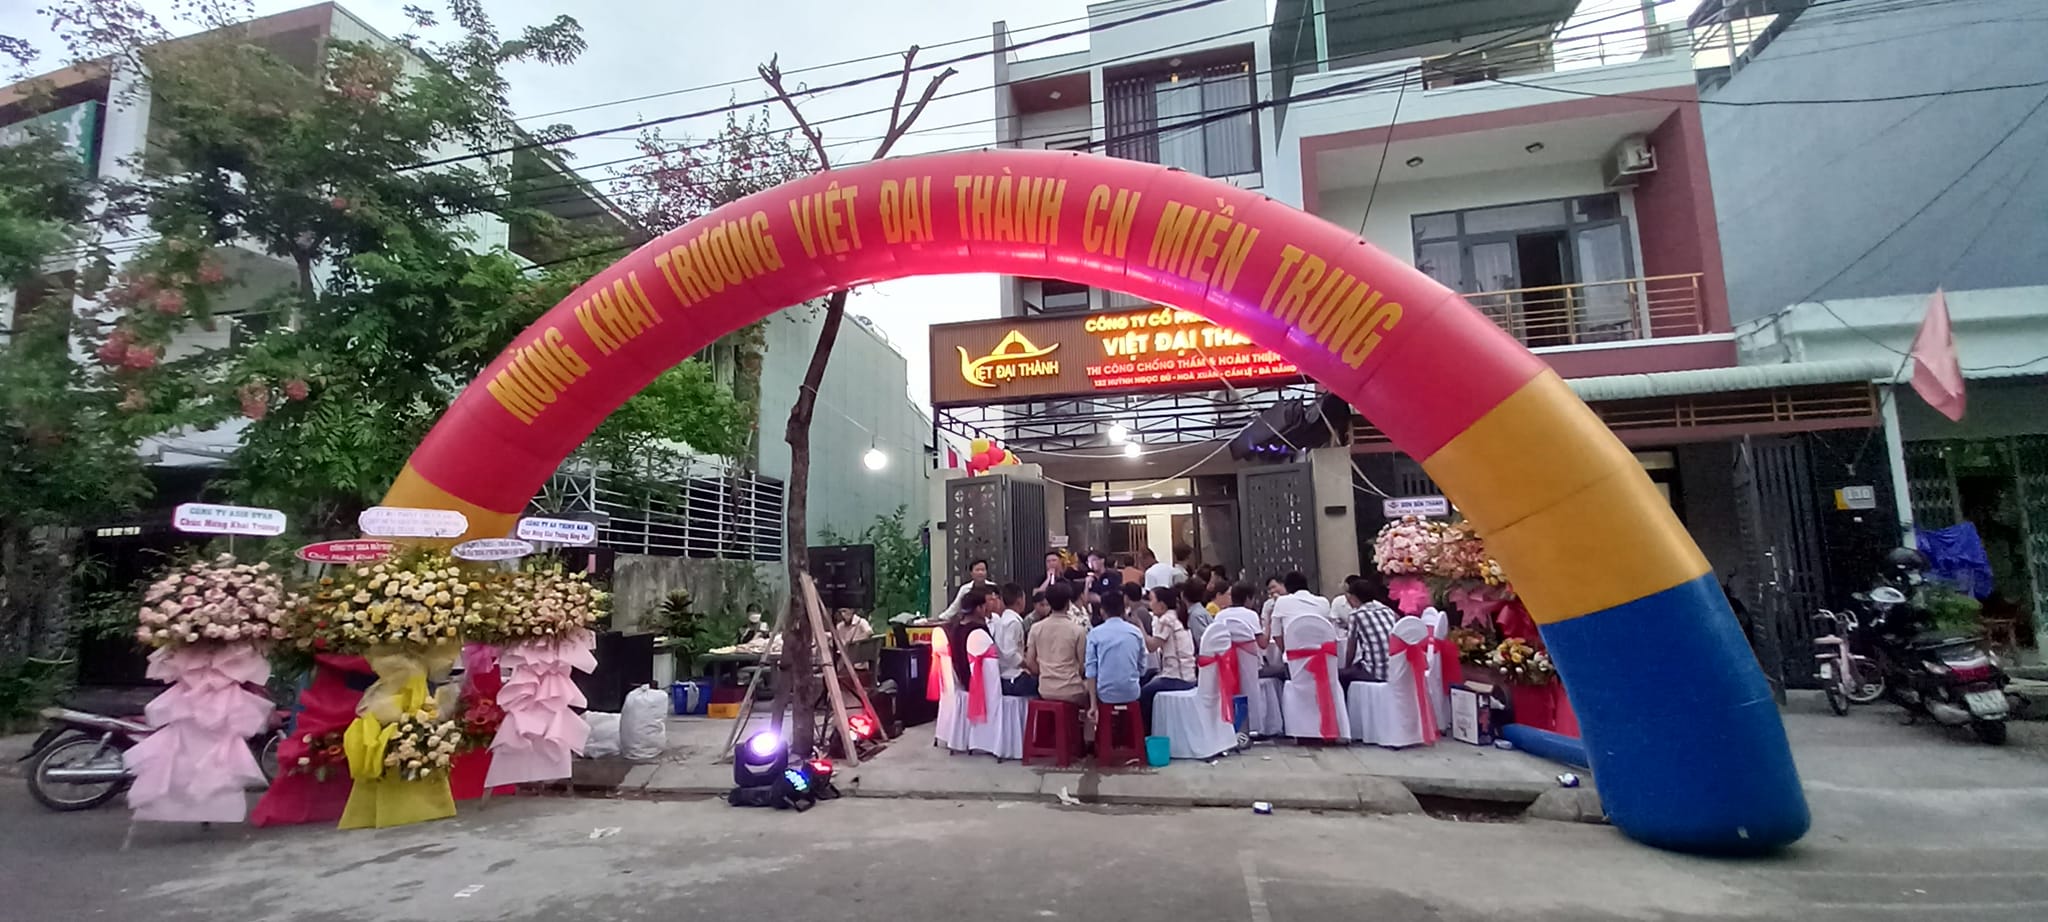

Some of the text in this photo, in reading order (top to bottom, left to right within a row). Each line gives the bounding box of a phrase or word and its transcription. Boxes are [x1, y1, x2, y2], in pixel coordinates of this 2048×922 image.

[486, 166, 1405, 425] MỪNG KHAI TRƯƠNG VIỆT ĐẠI THÀNH CN MIỀN TRUNG
[1085, 314, 1129, 332] CÔNG
[1130, 314, 1148, 329] TY
[1102, 331, 1150, 361] VIỆT
[1154, 329, 1199, 357] ĐẠI
[995, 363, 1016, 382] ĐẠI
[1017, 359, 1060, 377] THÀNH
[1086, 366, 1102, 376] THI
[1103, 363, 1135, 375] CÔNG
[1136, 359, 1175, 372] CHỐNG
[1208, 356, 1216, 366] &
[1218, 352, 1250, 366] HOÀN
[1251, 350, 1281, 365] THIỆN
[1134, 375, 1159, 384] NGỌC
[1197, 369, 1219, 380] XUÂN
